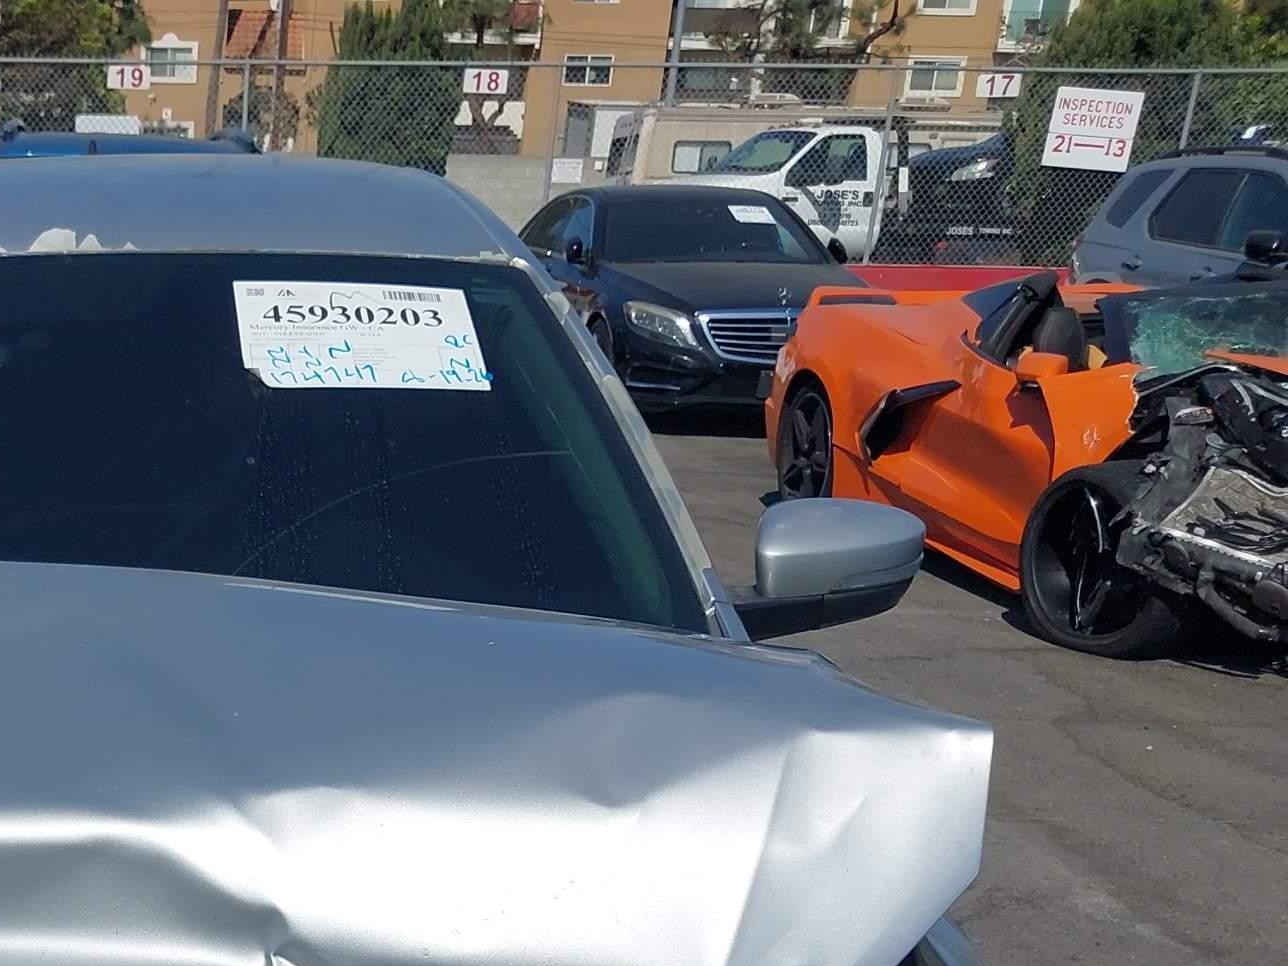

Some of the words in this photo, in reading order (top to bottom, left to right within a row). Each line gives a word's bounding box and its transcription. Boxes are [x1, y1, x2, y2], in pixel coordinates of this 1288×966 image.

[116, 67, 143, 88] 19
[472, 71, 500, 91] 18
[986, 75, 1015, 96] 17
[1058, 97, 1134, 115] INSPECTION
[1063, 113, 1125, 129] SERVICES
[816, 189, 860, 200] JOSE'S
[263, 304, 443, 328] 45930203
